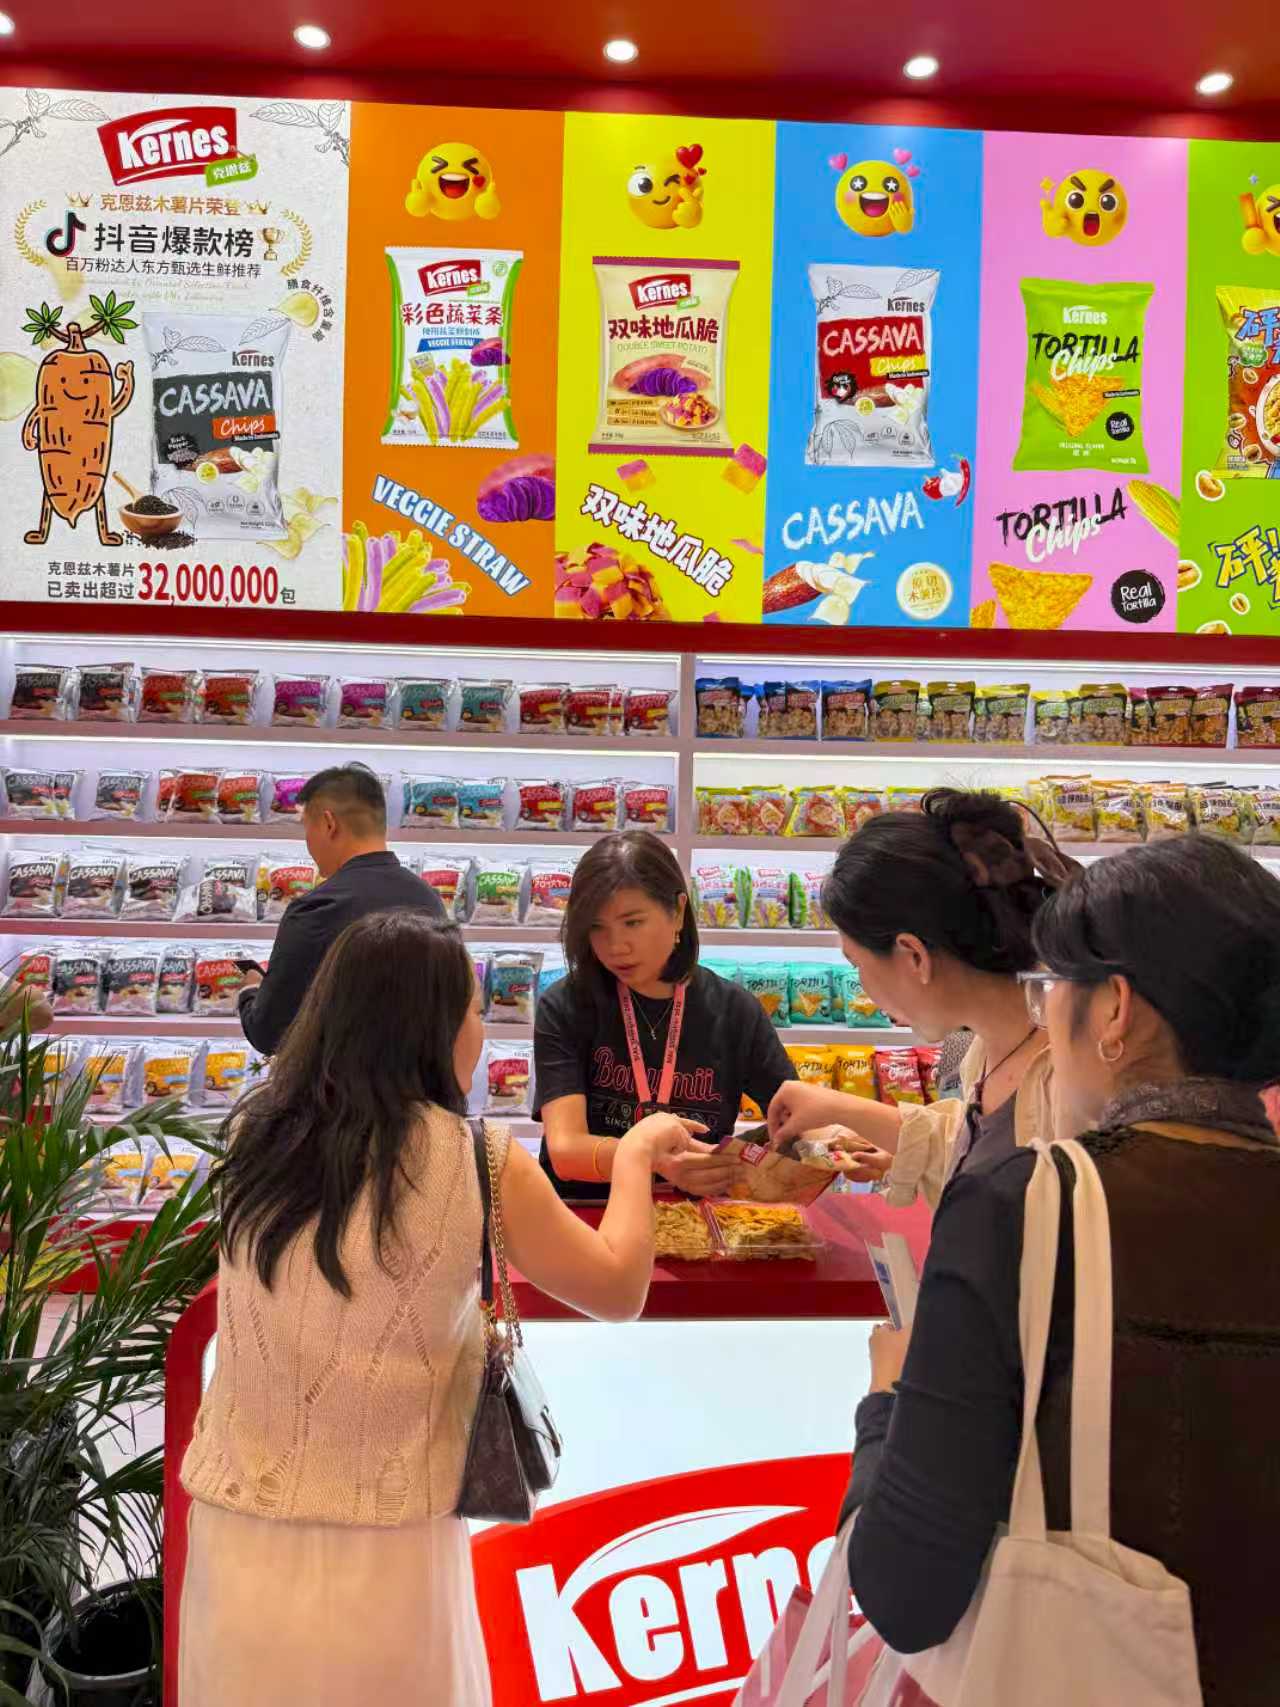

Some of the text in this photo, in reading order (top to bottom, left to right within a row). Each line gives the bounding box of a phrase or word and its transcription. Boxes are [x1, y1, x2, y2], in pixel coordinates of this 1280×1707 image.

[117, 119, 230, 170] Kernes
[100, 193, 241, 217] 克恩兹木薯片荣登
[95, 222, 254, 258] 抖音爆款榜
[65, 257, 262, 279] 百万粉达人东方甄选生鲜推荐
[426, 266, 479, 290] Kernes
[637, 280, 688, 303] Kernes
[887, 297, 925, 313] Kernes
[402, 302, 503, 326] 彩色蔬菜条
[608, 314, 719, 344] 双味地瓜脆
[1062, 305, 1108, 325] Kernes
[822, 322, 921, 356] CASSAVA
[1032, 332, 1140, 363] TORTILLA
[232, 350, 275, 368] Kernes
[1051, 346, 1118, 382] Chips
[159, 378, 271, 417] CASSAVA
[220, 417, 266, 436] Chips
[782, 491, 925, 550] CASSAVA
[995, 487, 1128, 546] TORTILLA
[372, 474, 532, 597] VEGGIE STRAW
[580, 483, 735, 597] 双味地瓜脆
[1025, 513, 1102, 563] Chips
[47, 561, 135, 577] 克恩兹木薯片
[47, 581, 135, 599] 已卖出超过
[138, 562, 278, 607] 32,000,000
[1120, 582, 1153, 600] Real
[515, 1506, 840, 1702] Kern
